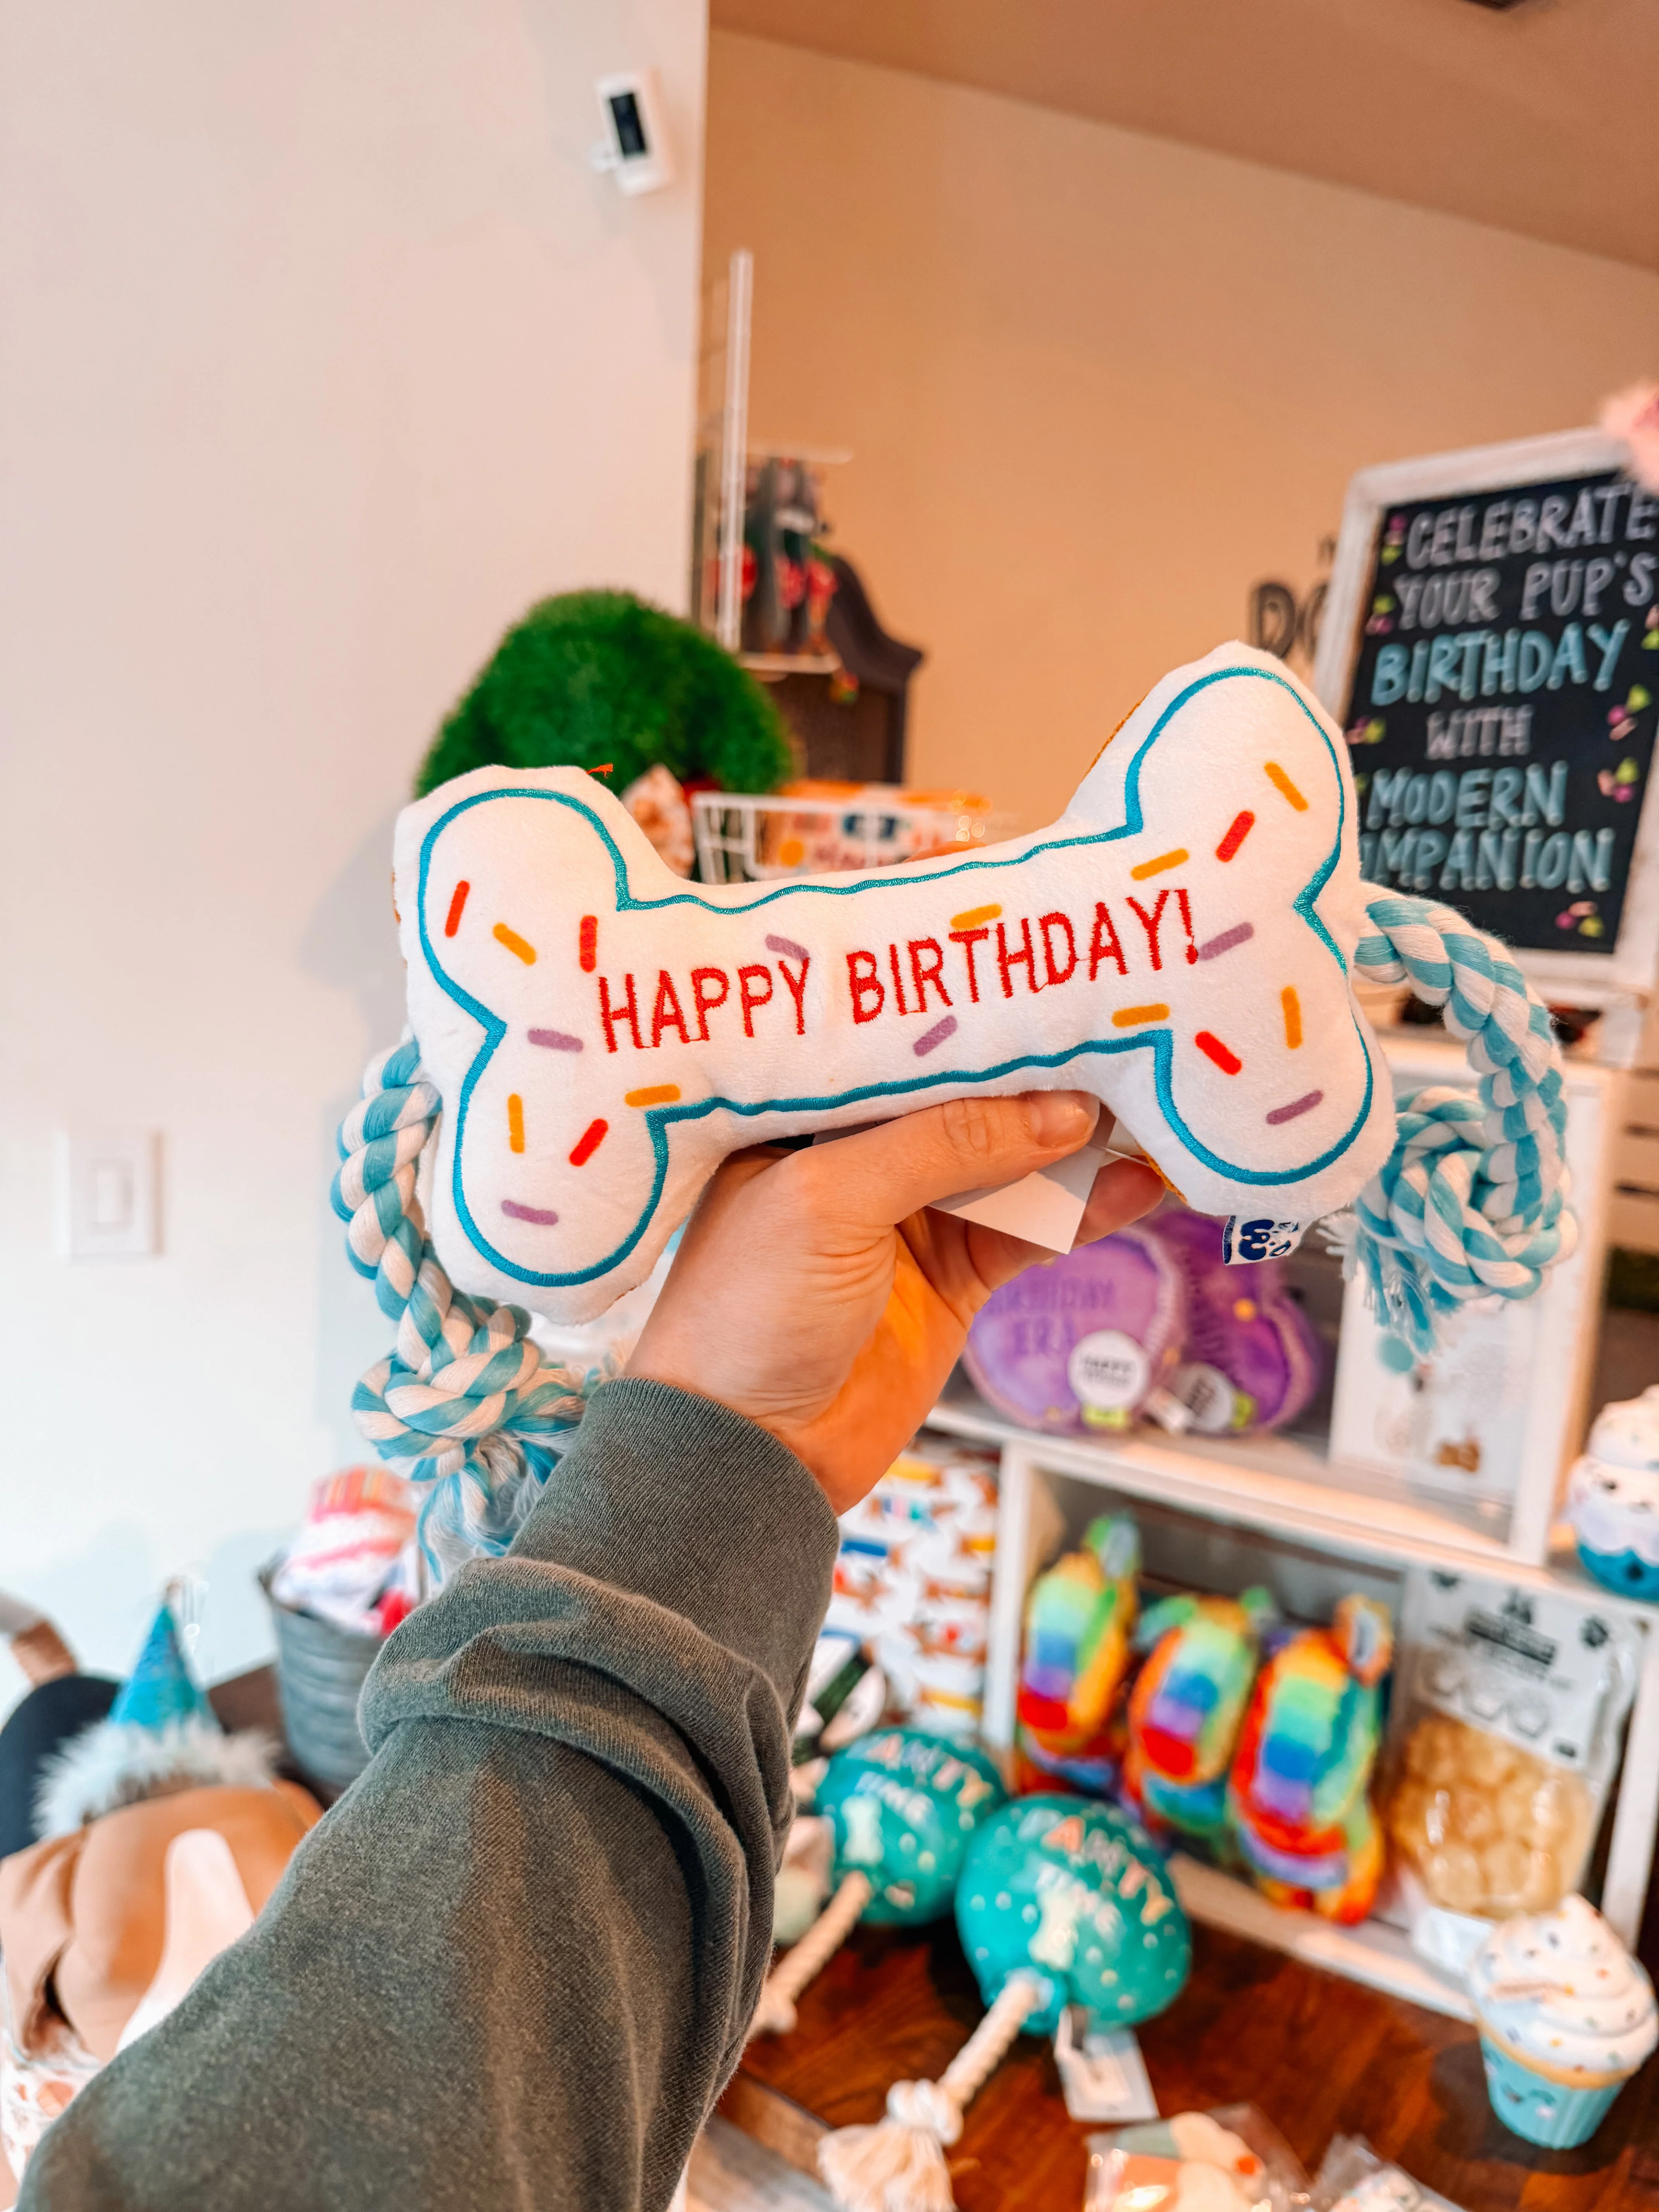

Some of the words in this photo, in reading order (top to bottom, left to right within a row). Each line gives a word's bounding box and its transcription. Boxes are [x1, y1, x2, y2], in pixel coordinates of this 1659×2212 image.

[1407, 483, 1659, 569] CELEBRATE
[1393, 568, 1501, 630] YOUR
[1519, 551, 1659, 620] PUP'S
[1370, 618, 1631, 706] BIRTHDAY
[1426, 704, 1533, 760] WITH
[1365, 759, 1568, 831] MODERN
[599, 957, 810, 1053] HAPPY
[847, 889, 1198, 1024] BIRTHDAY!
